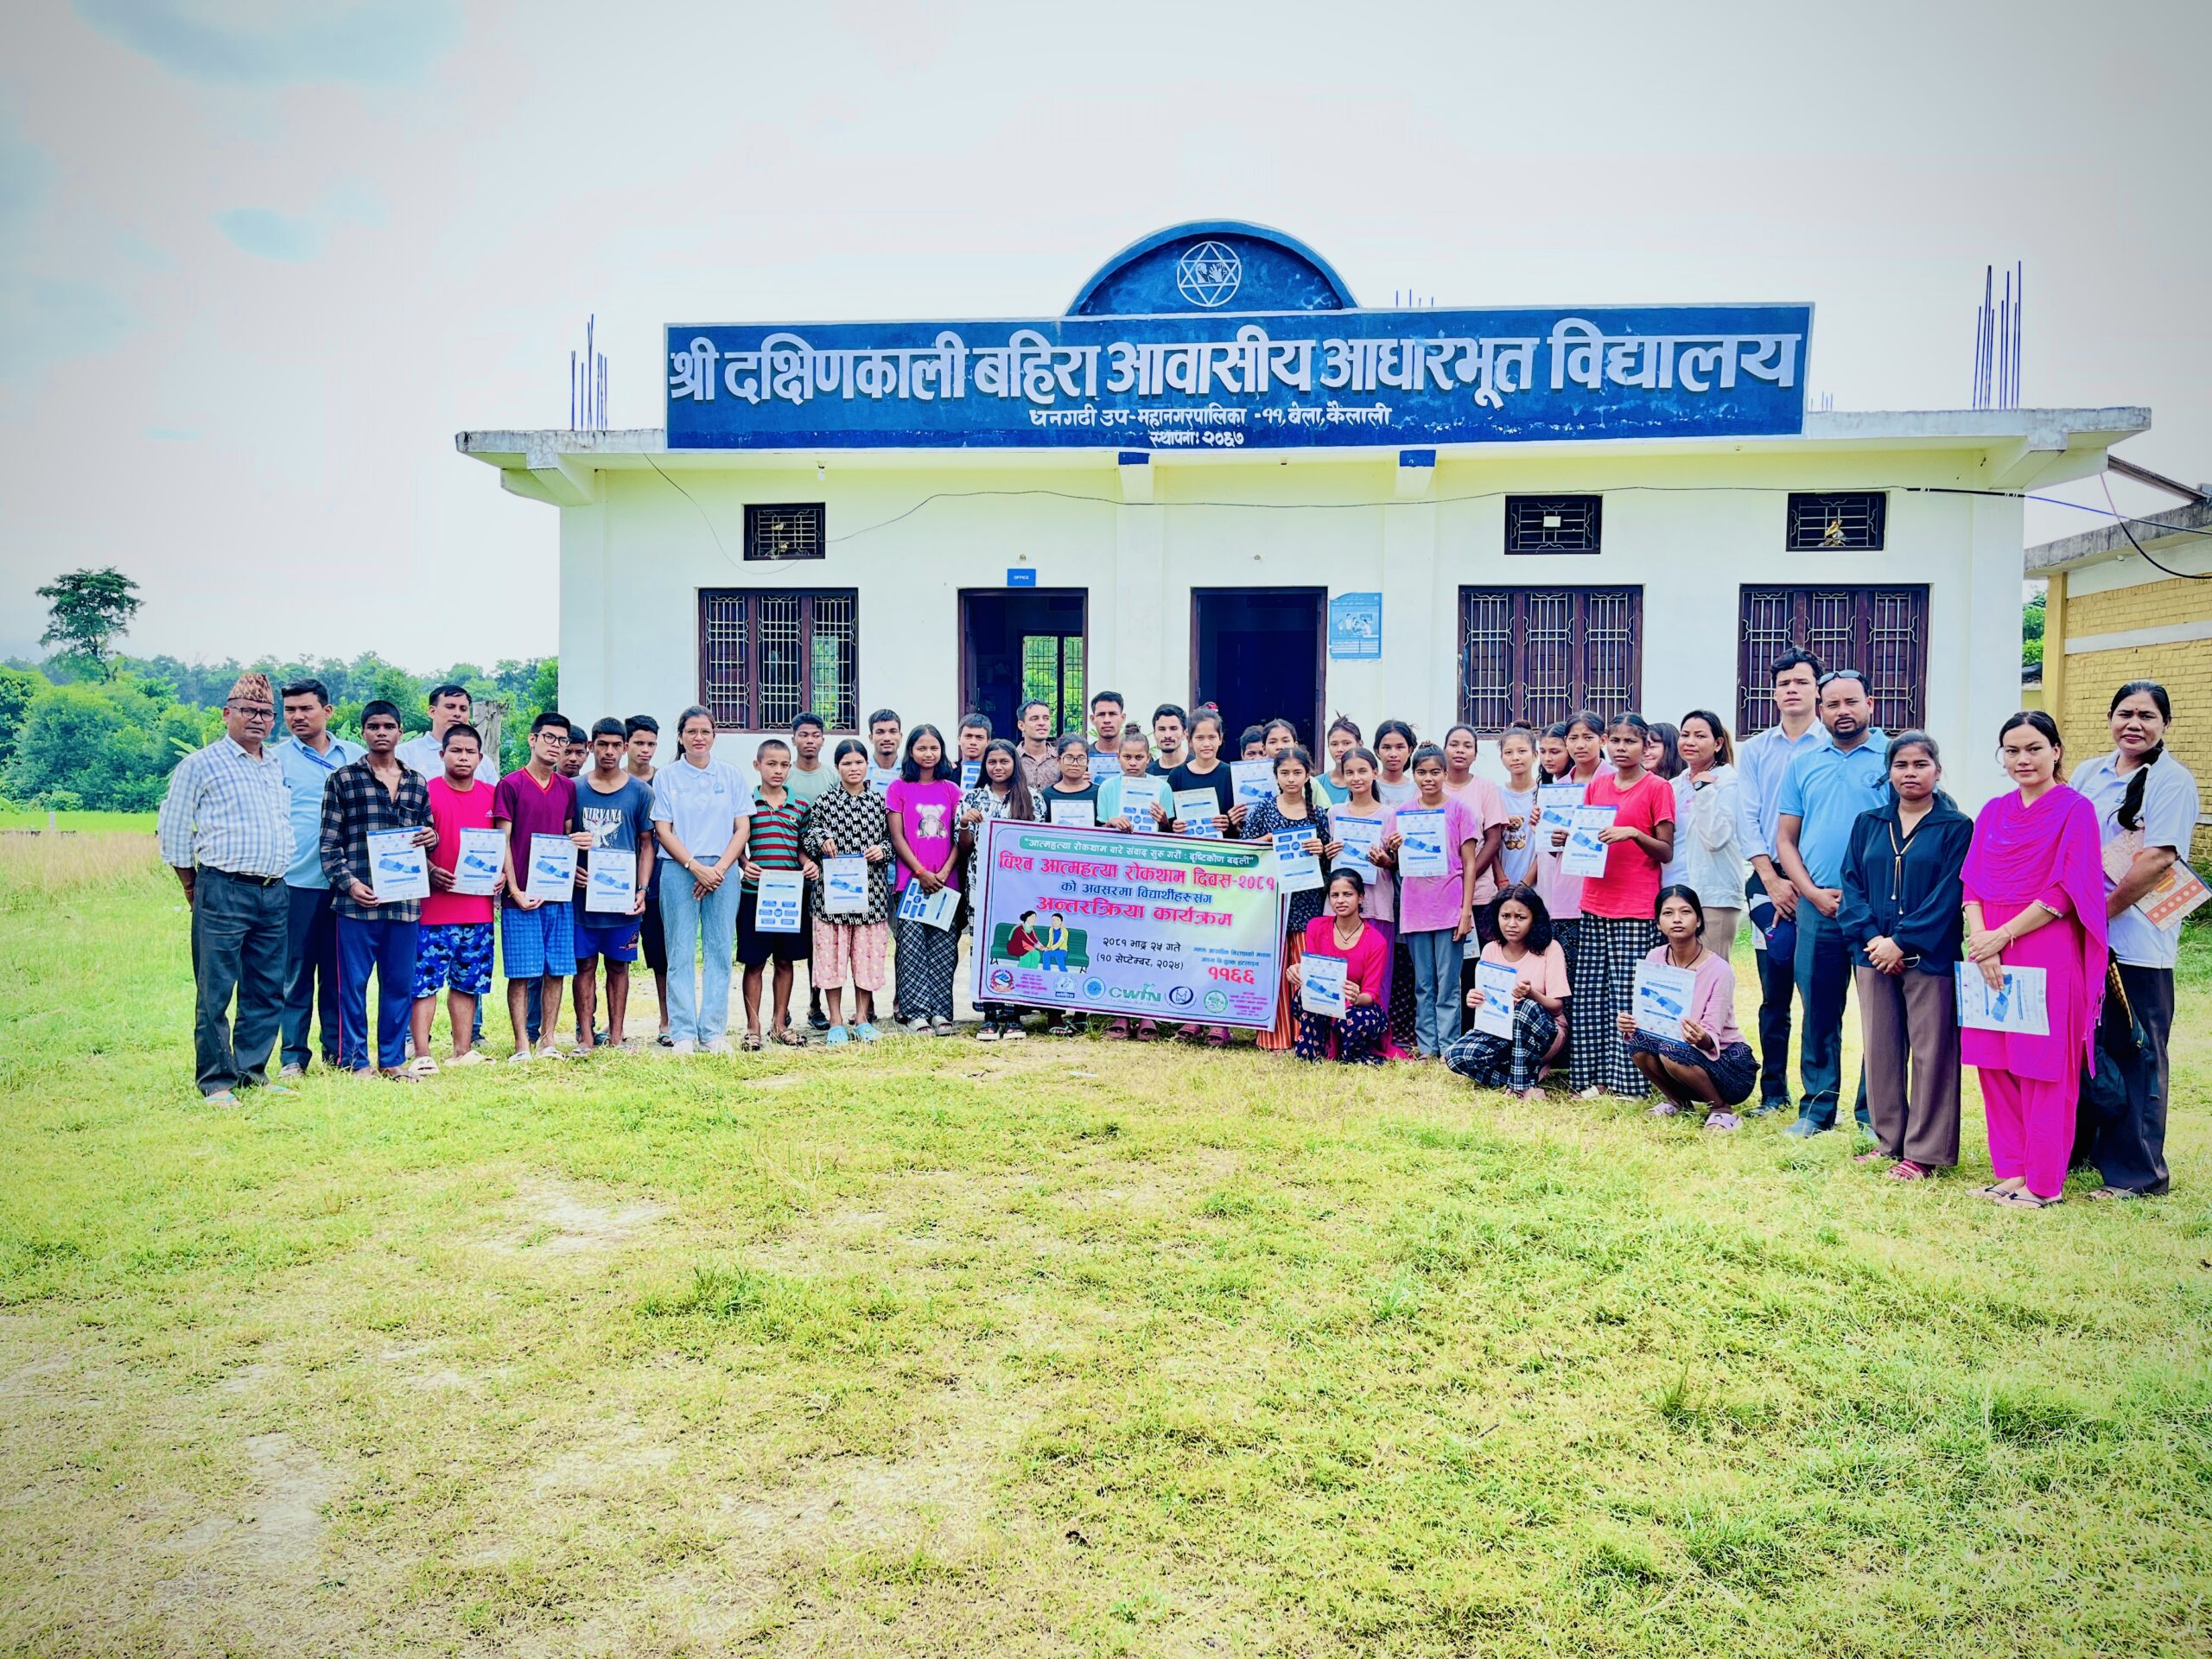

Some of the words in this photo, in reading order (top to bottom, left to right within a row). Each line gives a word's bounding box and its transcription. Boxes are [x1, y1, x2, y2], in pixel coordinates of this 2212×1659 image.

[669, 335, 719, 401] श्री
[725, 330, 967, 404] दक्षिणकाली
[973, 328, 1101, 404] बहिरा
[1107, 324, 1316, 397] आवासीय
[1320, 335, 1540, 409] आधारभूत
[1548, 317, 1802, 393] विद्यालय
[1029, 404, 1097, 428] धनगढी
[583, 807, 622, 822] NIRVANA
[999, 850, 1033, 871] विश्व
[1040, 858, 1118, 879] आत्महत्या
[1125, 861, 1185, 885] रोकथाम
[1061, 880, 1077, 893] को
[1083, 883, 1132, 897] अवसरमा
[1037, 896, 1145, 919] अन्तरक्रिया
[1153, 906, 1233, 927] कार्यक्रम
[1103, 938, 1127, 947] २०८१
[1166, 942, 1181, 952] गते
[1208, 966, 1255, 985] ११६६
